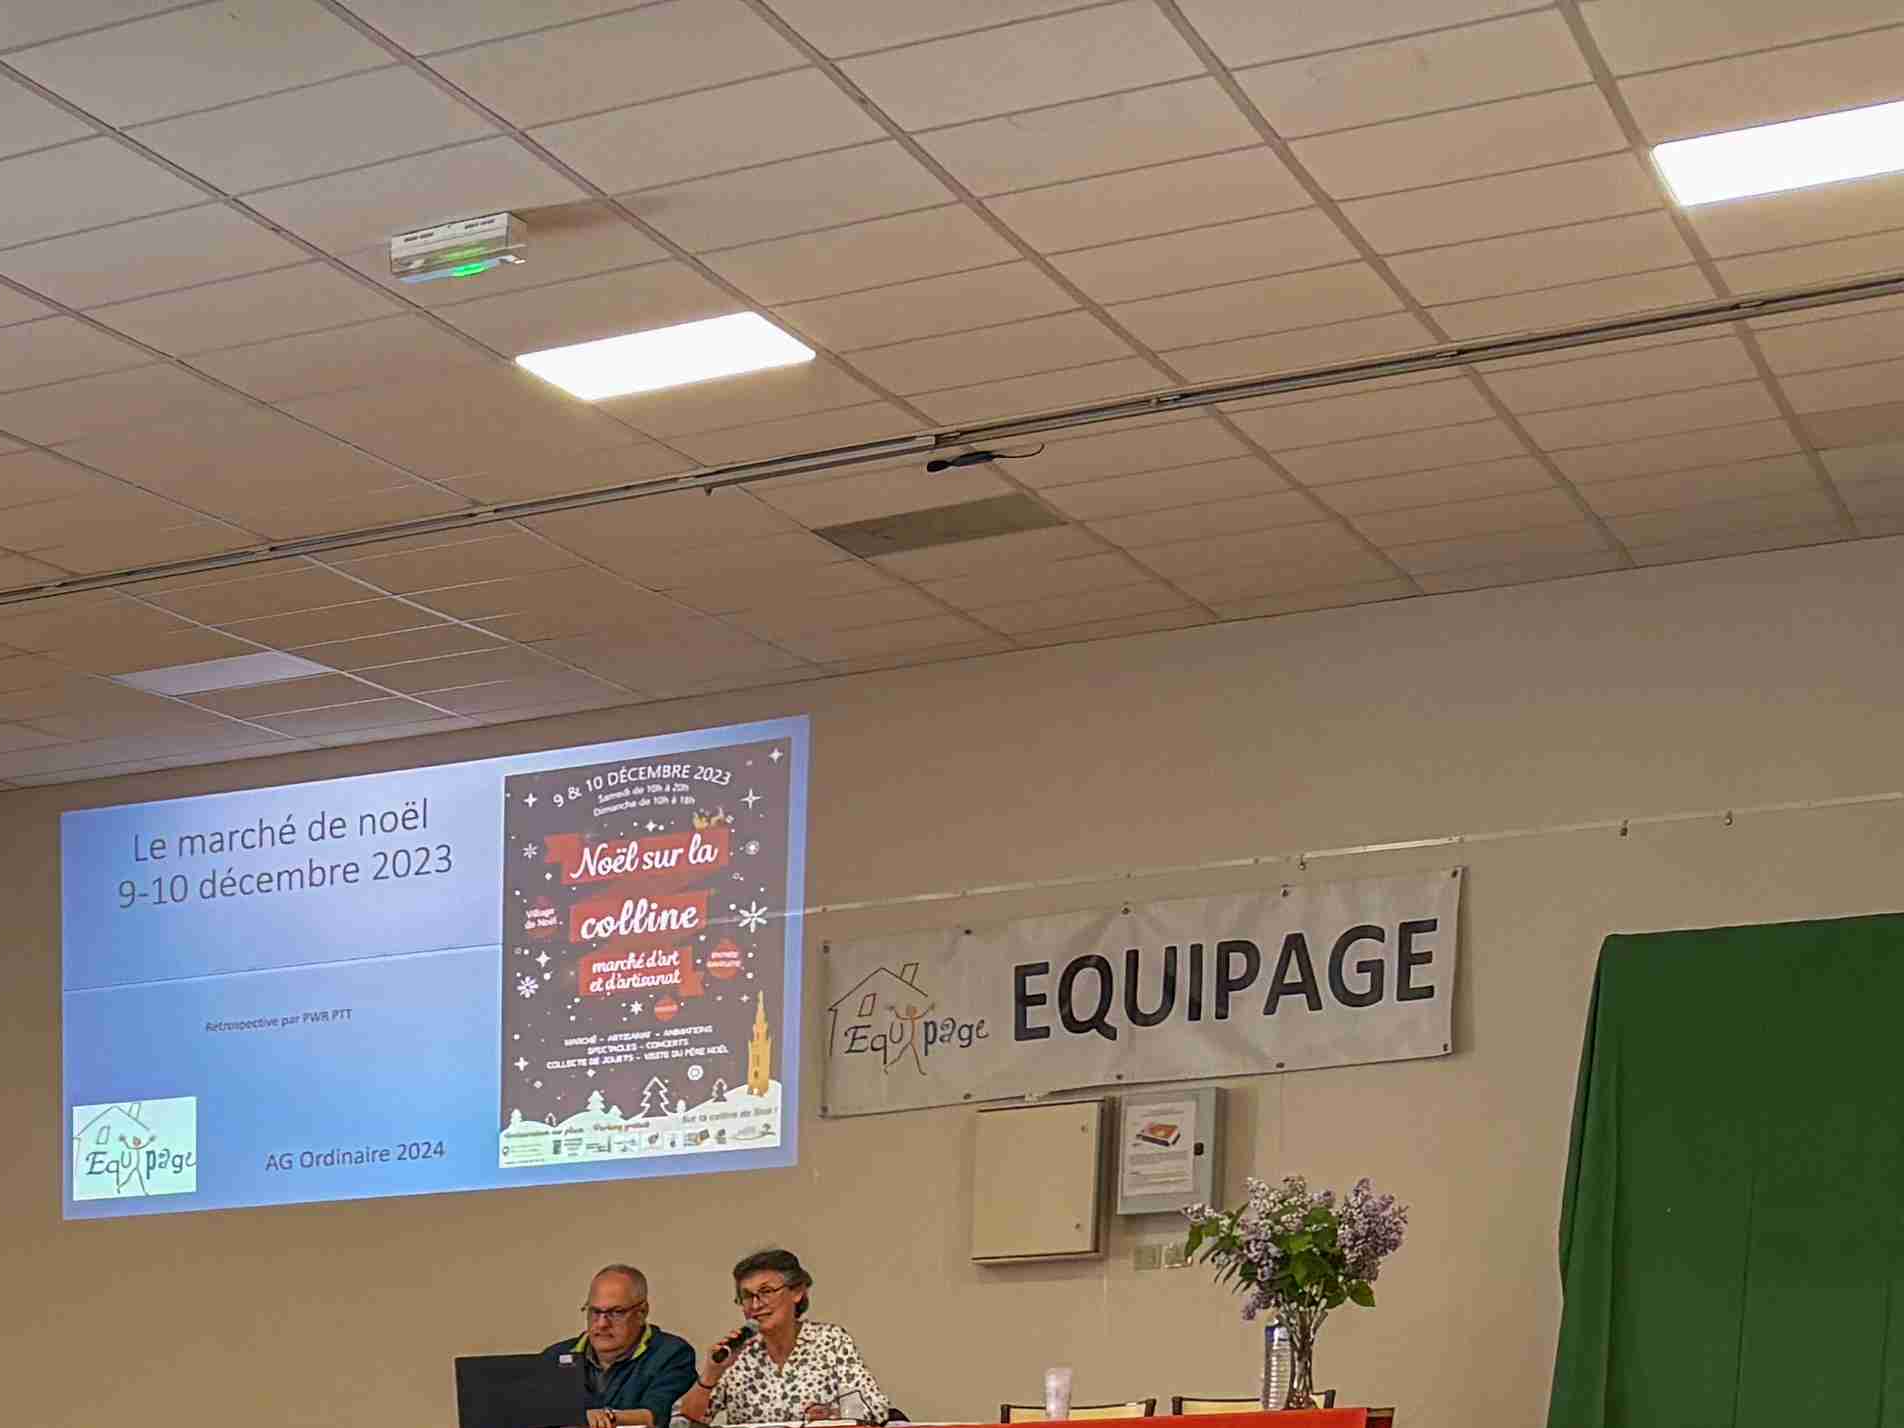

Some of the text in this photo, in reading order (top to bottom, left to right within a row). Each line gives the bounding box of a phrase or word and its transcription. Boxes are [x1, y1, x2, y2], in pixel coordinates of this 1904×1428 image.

[552, 764, 732, 807] 9 & 10 DÉCEMBRE 2023
[133, 798, 429, 862] Le marché de noël
[118, 843, 454, 909] 9-10 décembre 2023
[569, 832, 719, 880] Noël sur la
[580, 897, 700, 940] colline
[589, 968, 682, 993] et d'artisanat
[592, 949, 681, 974] marché d'art
[1013, 917, 1439, 1043] EQUIPAGE
[265, 1140, 447, 1172] AG Ordinaire 2024
